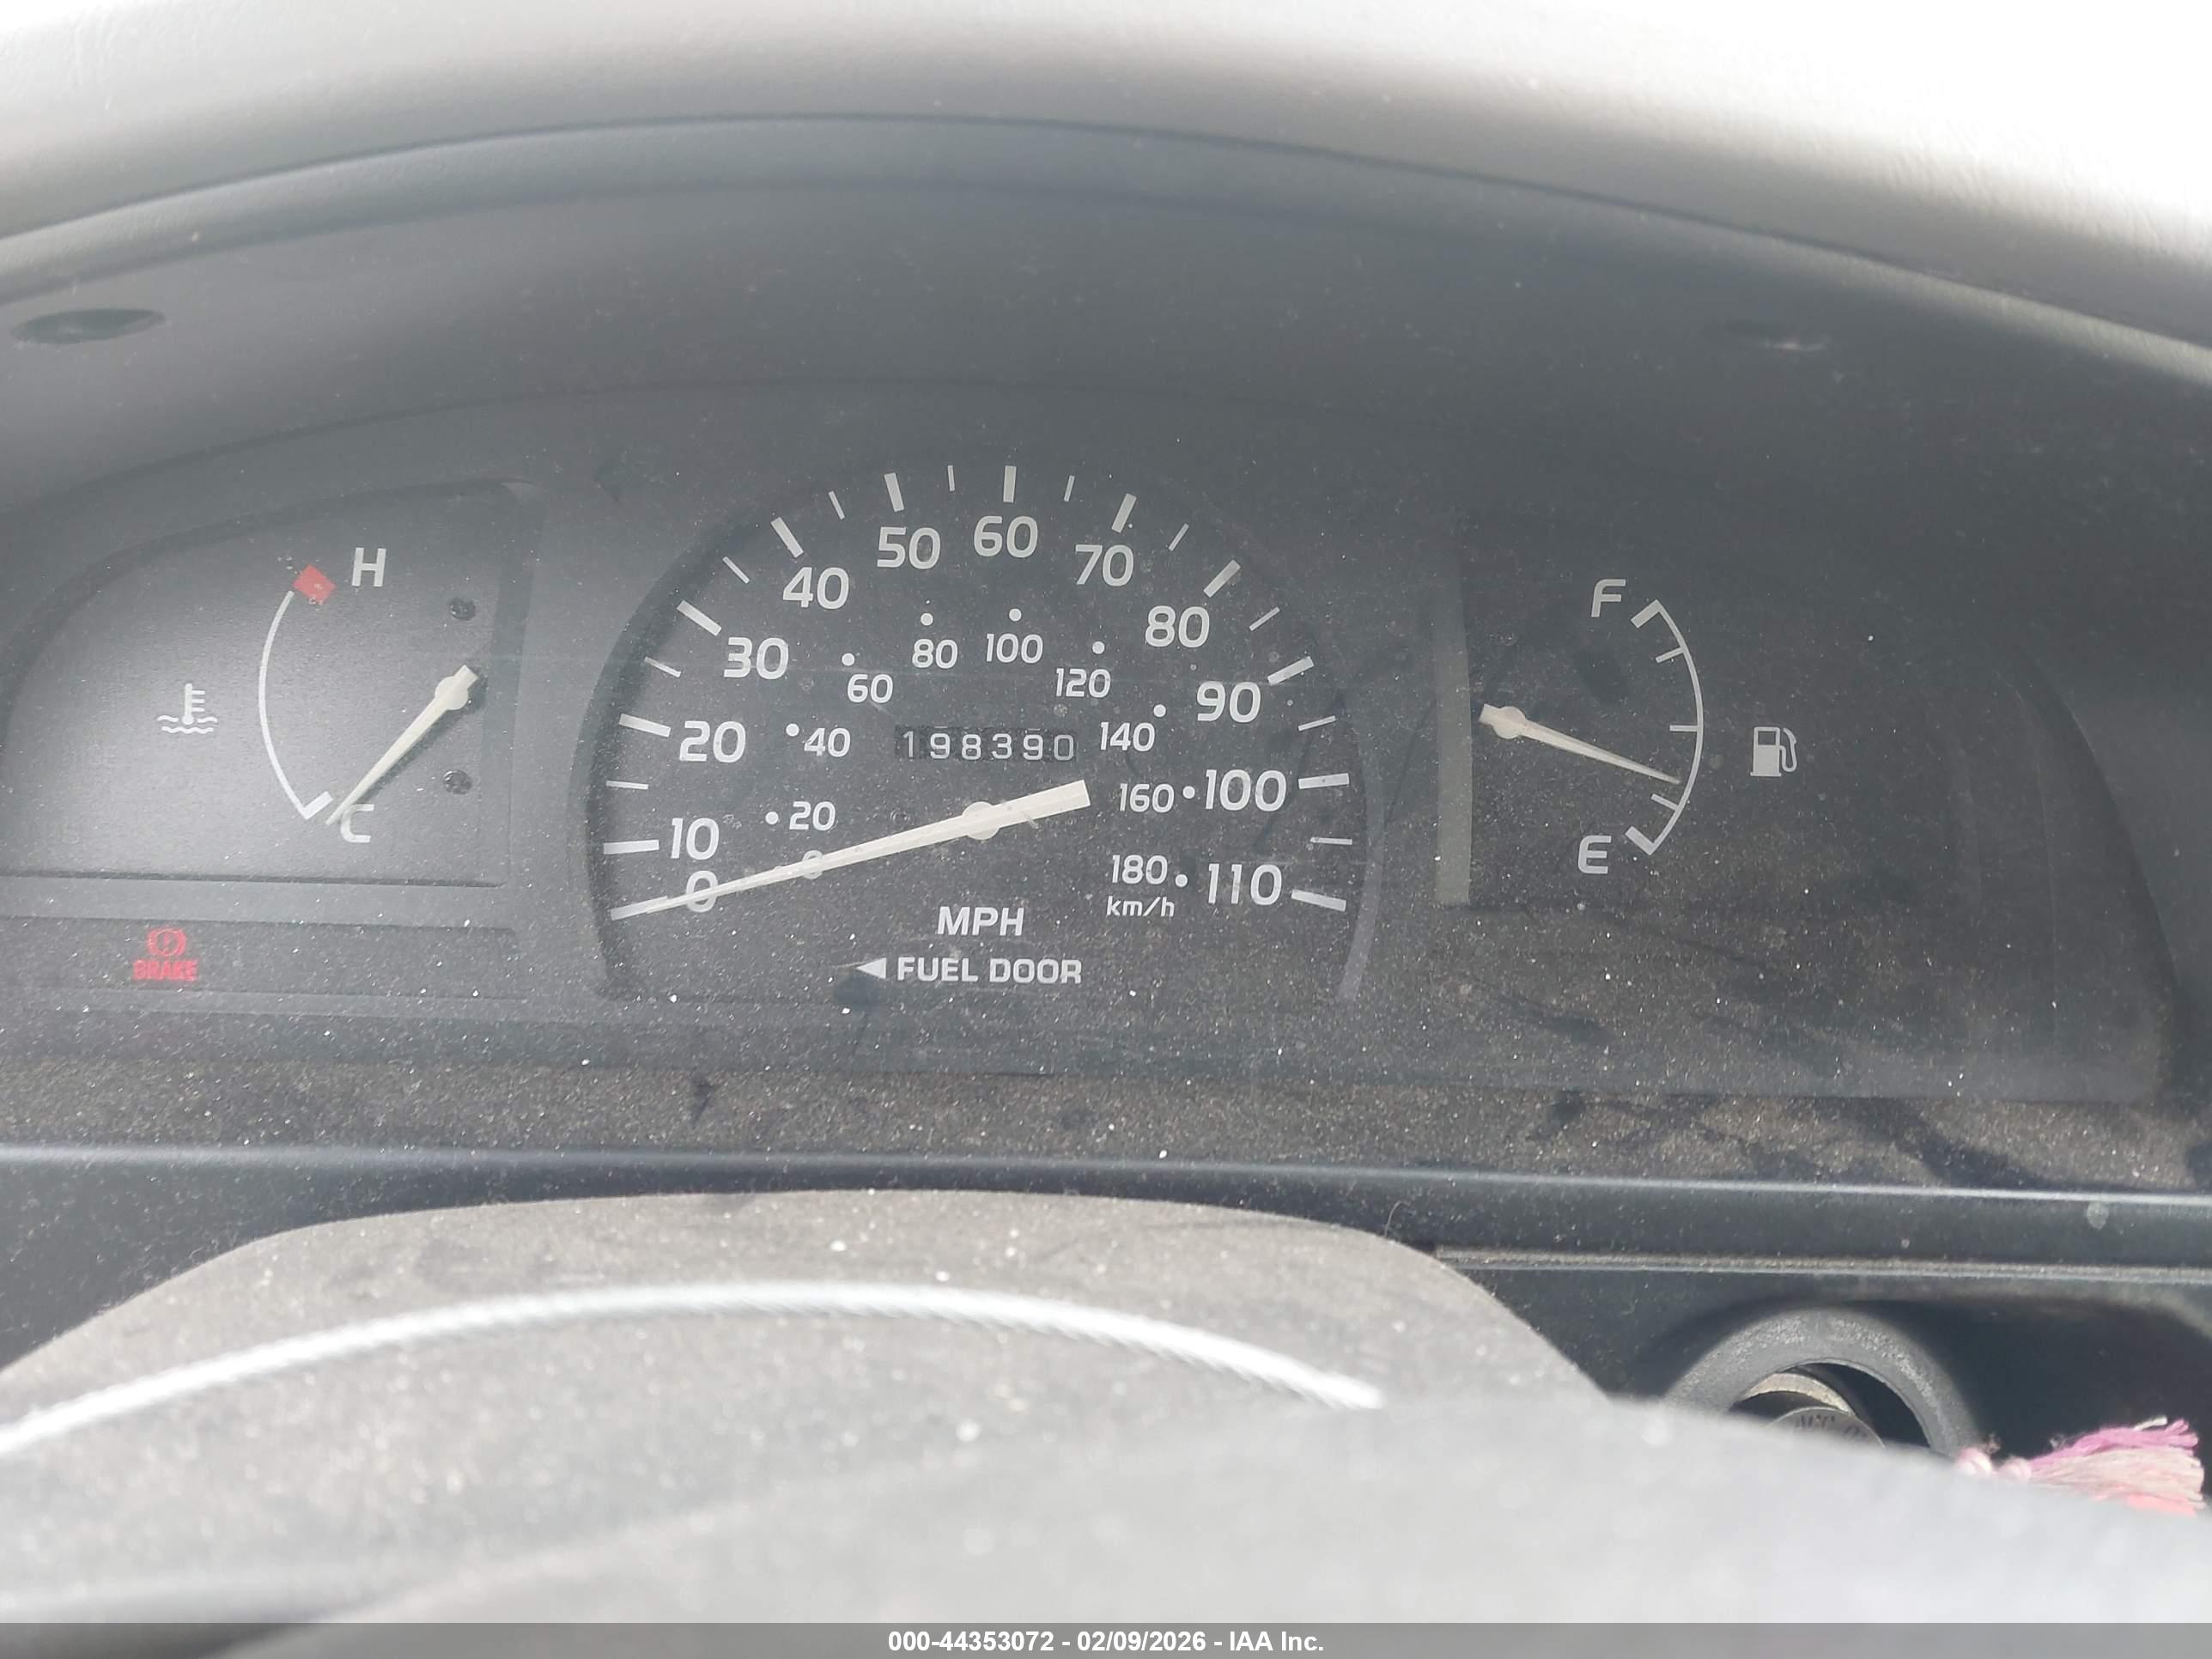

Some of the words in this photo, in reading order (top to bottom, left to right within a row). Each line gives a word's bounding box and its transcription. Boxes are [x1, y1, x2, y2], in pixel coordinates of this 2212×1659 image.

[877, 526, 941, 569] 50
[973, 515, 1038, 558] 60
[351, 547, 386, 587] H
[1075, 544, 1134, 586] 70
[782, 567, 849, 610] 40
[1591, 579, 1626, 617] F
[1145, 605, 1210, 648] 80
[724, 636, 789, 680] 30
[912, 639, 958, 669] 80
[986, 633, 1043, 665] 100
[847, 673, 894, 704] 60
[1055, 668, 1111, 698] 120
[1197, 681, 1261, 723] 90
[678, 720, 746, 763] 20
[804, 727, 851, 757] 40
[902, 731, 1073, 761] 198390
[1100, 721, 1156, 752] 140
[1119, 783, 1175, 813] 160
[1205, 769, 1286, 811] 100
[340, 804, 374, 842] C
[789, 801, 836, 830] 20
[670, 817, 720, 860] 10
[1577, 836, 1612, 874] E
[1112, 854, 1168, 885] 180
[1207, 863, 1282, 906] 110
[686, 870, 718, 913] 0
[1106, 896, 1175, 918] km/h
[937, 906, 1025, 936] MPH
[133, 959, 198, 981] BRAKE
[896, 957, 978, 982] FUEL
[989, 958, 1082, 984] DOOR
